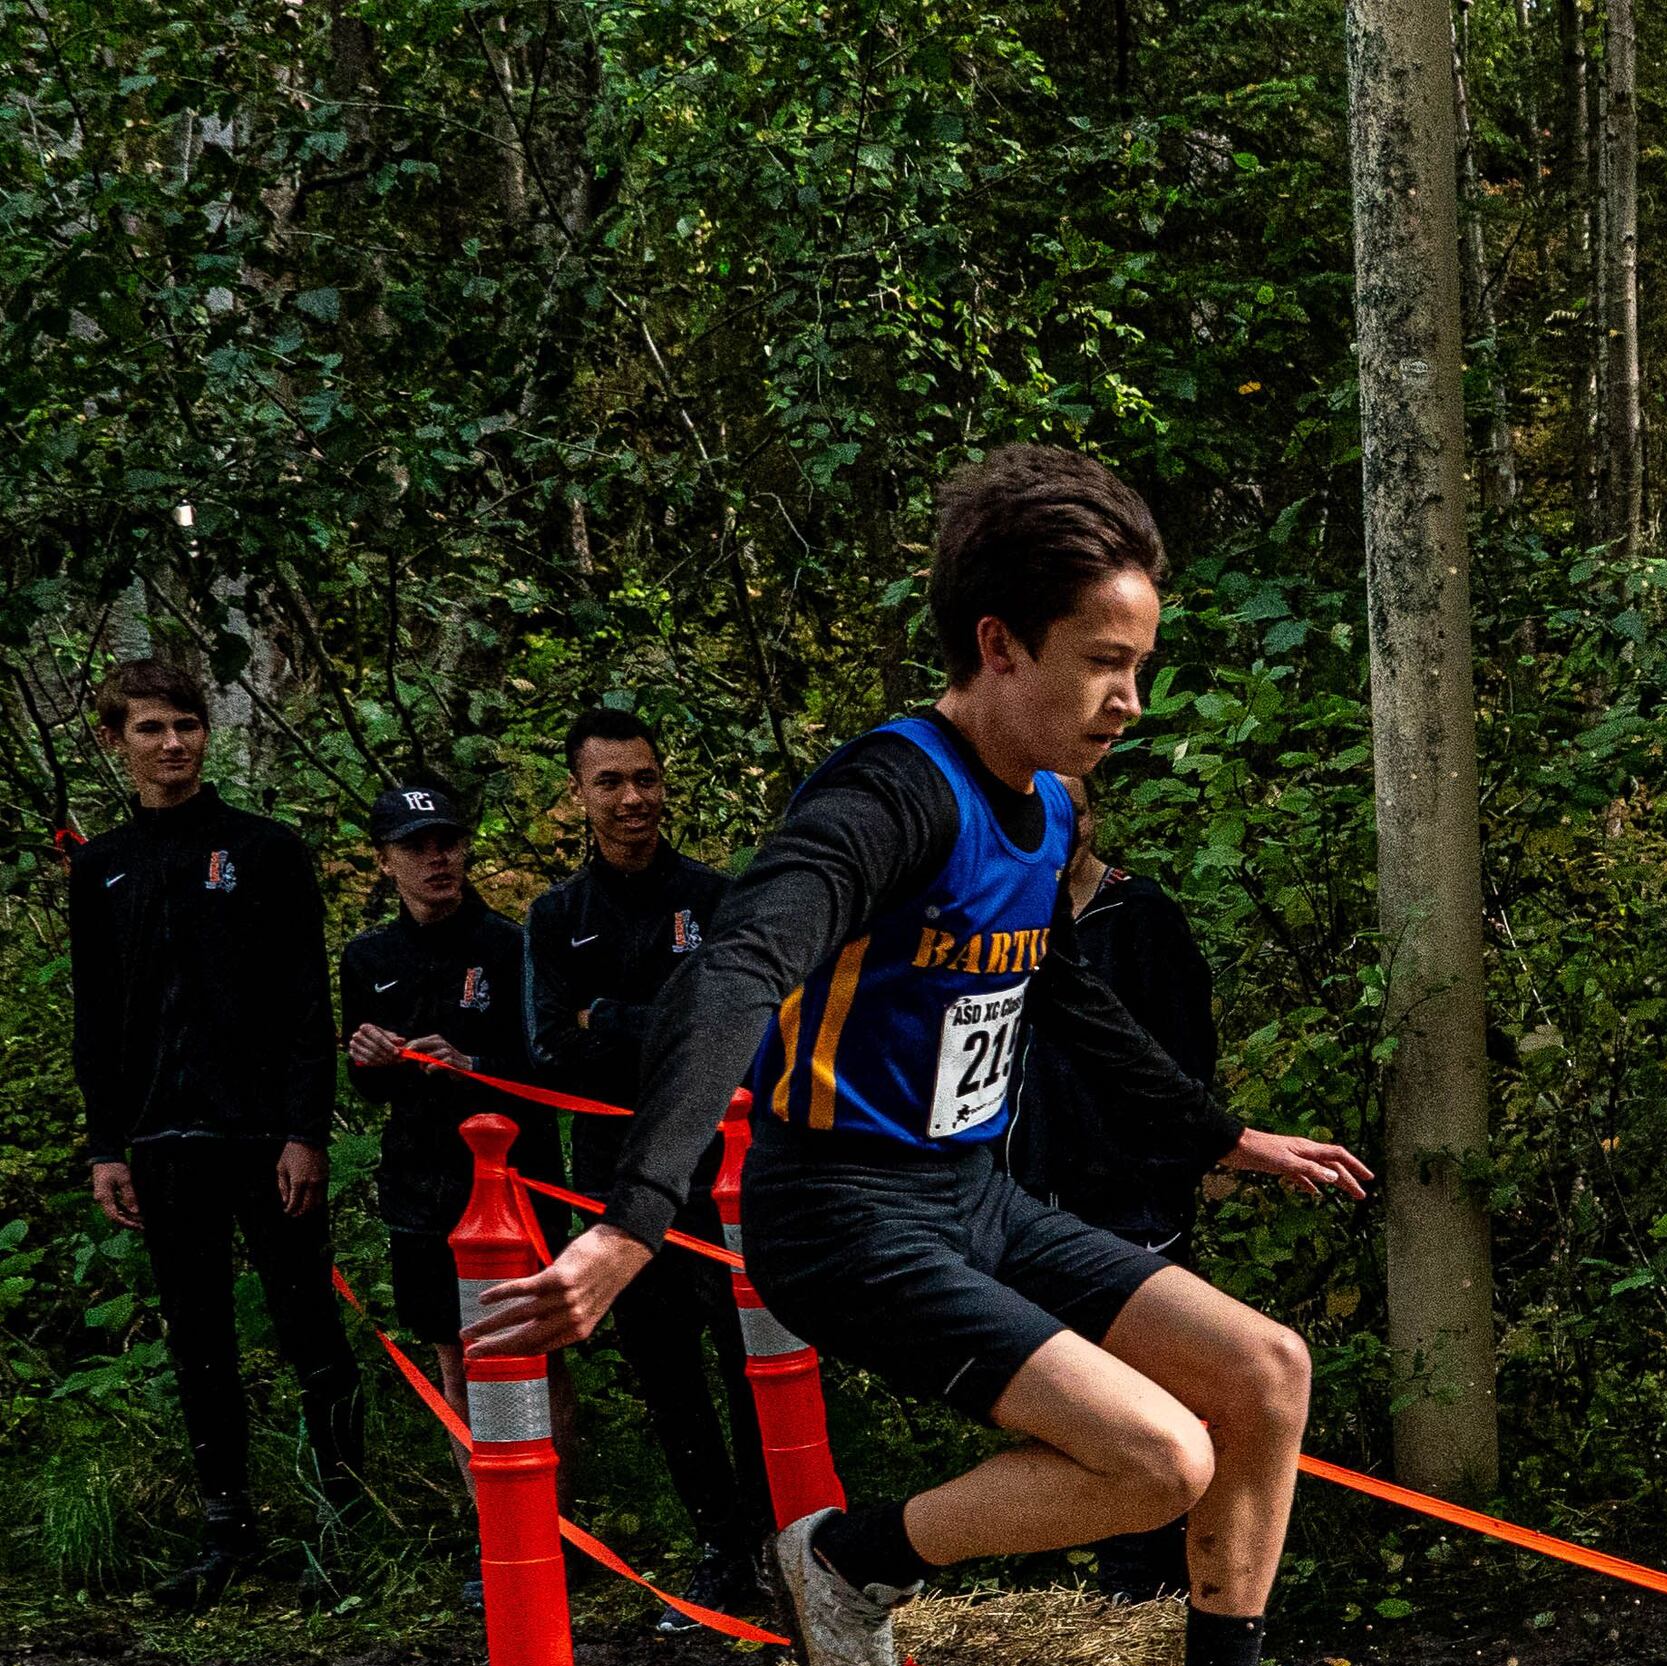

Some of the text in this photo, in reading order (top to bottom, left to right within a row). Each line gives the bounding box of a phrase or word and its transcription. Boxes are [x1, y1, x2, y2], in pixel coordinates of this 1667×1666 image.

[401, 791, 435, 811] PG
[952, 1004, 982, 1026] ASD
[984, 1001, 1000, 1022] XC
